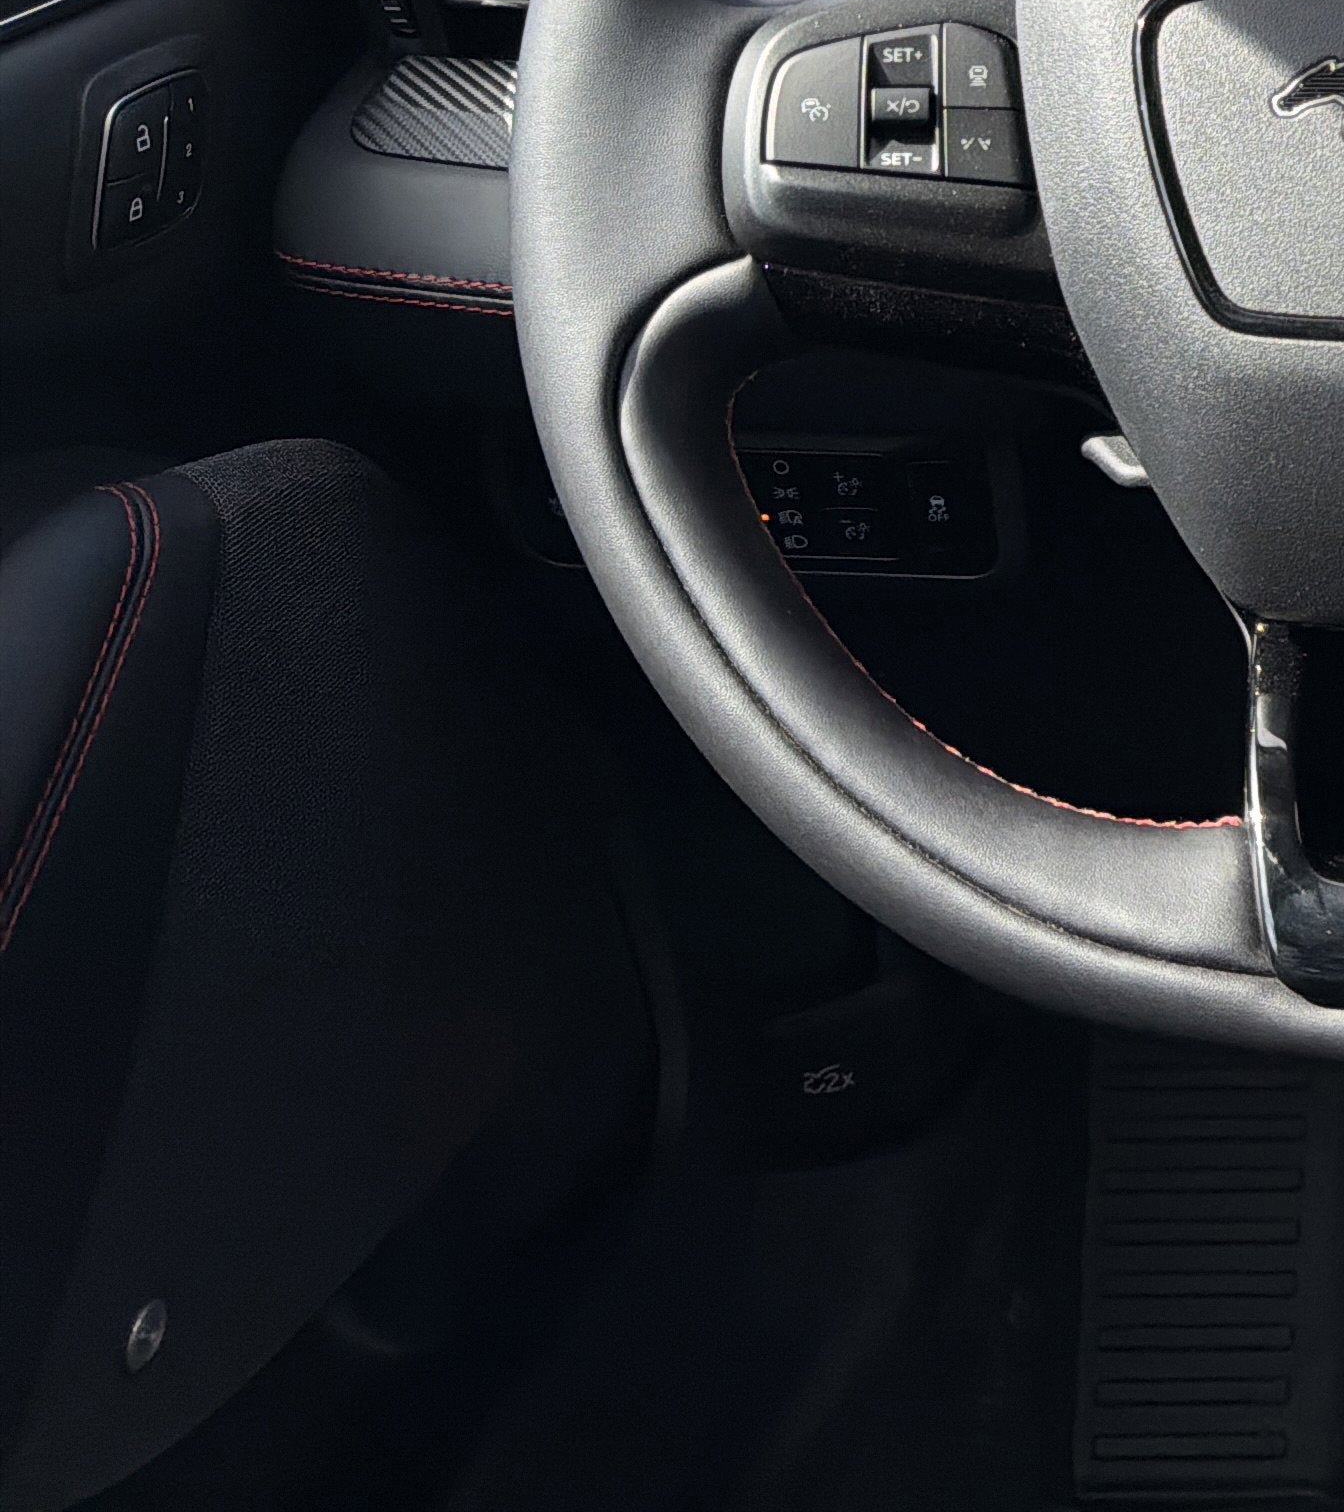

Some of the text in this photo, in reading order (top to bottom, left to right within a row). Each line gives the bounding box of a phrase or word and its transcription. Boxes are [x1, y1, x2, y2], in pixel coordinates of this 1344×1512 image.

[882, 47, 924, 63] SET+
[188, 97, 194, 112] 1
[185, 143, 193, 158] 2
[177, 190, 185, 204] 3
[927, 513, 950, 523] OFF
